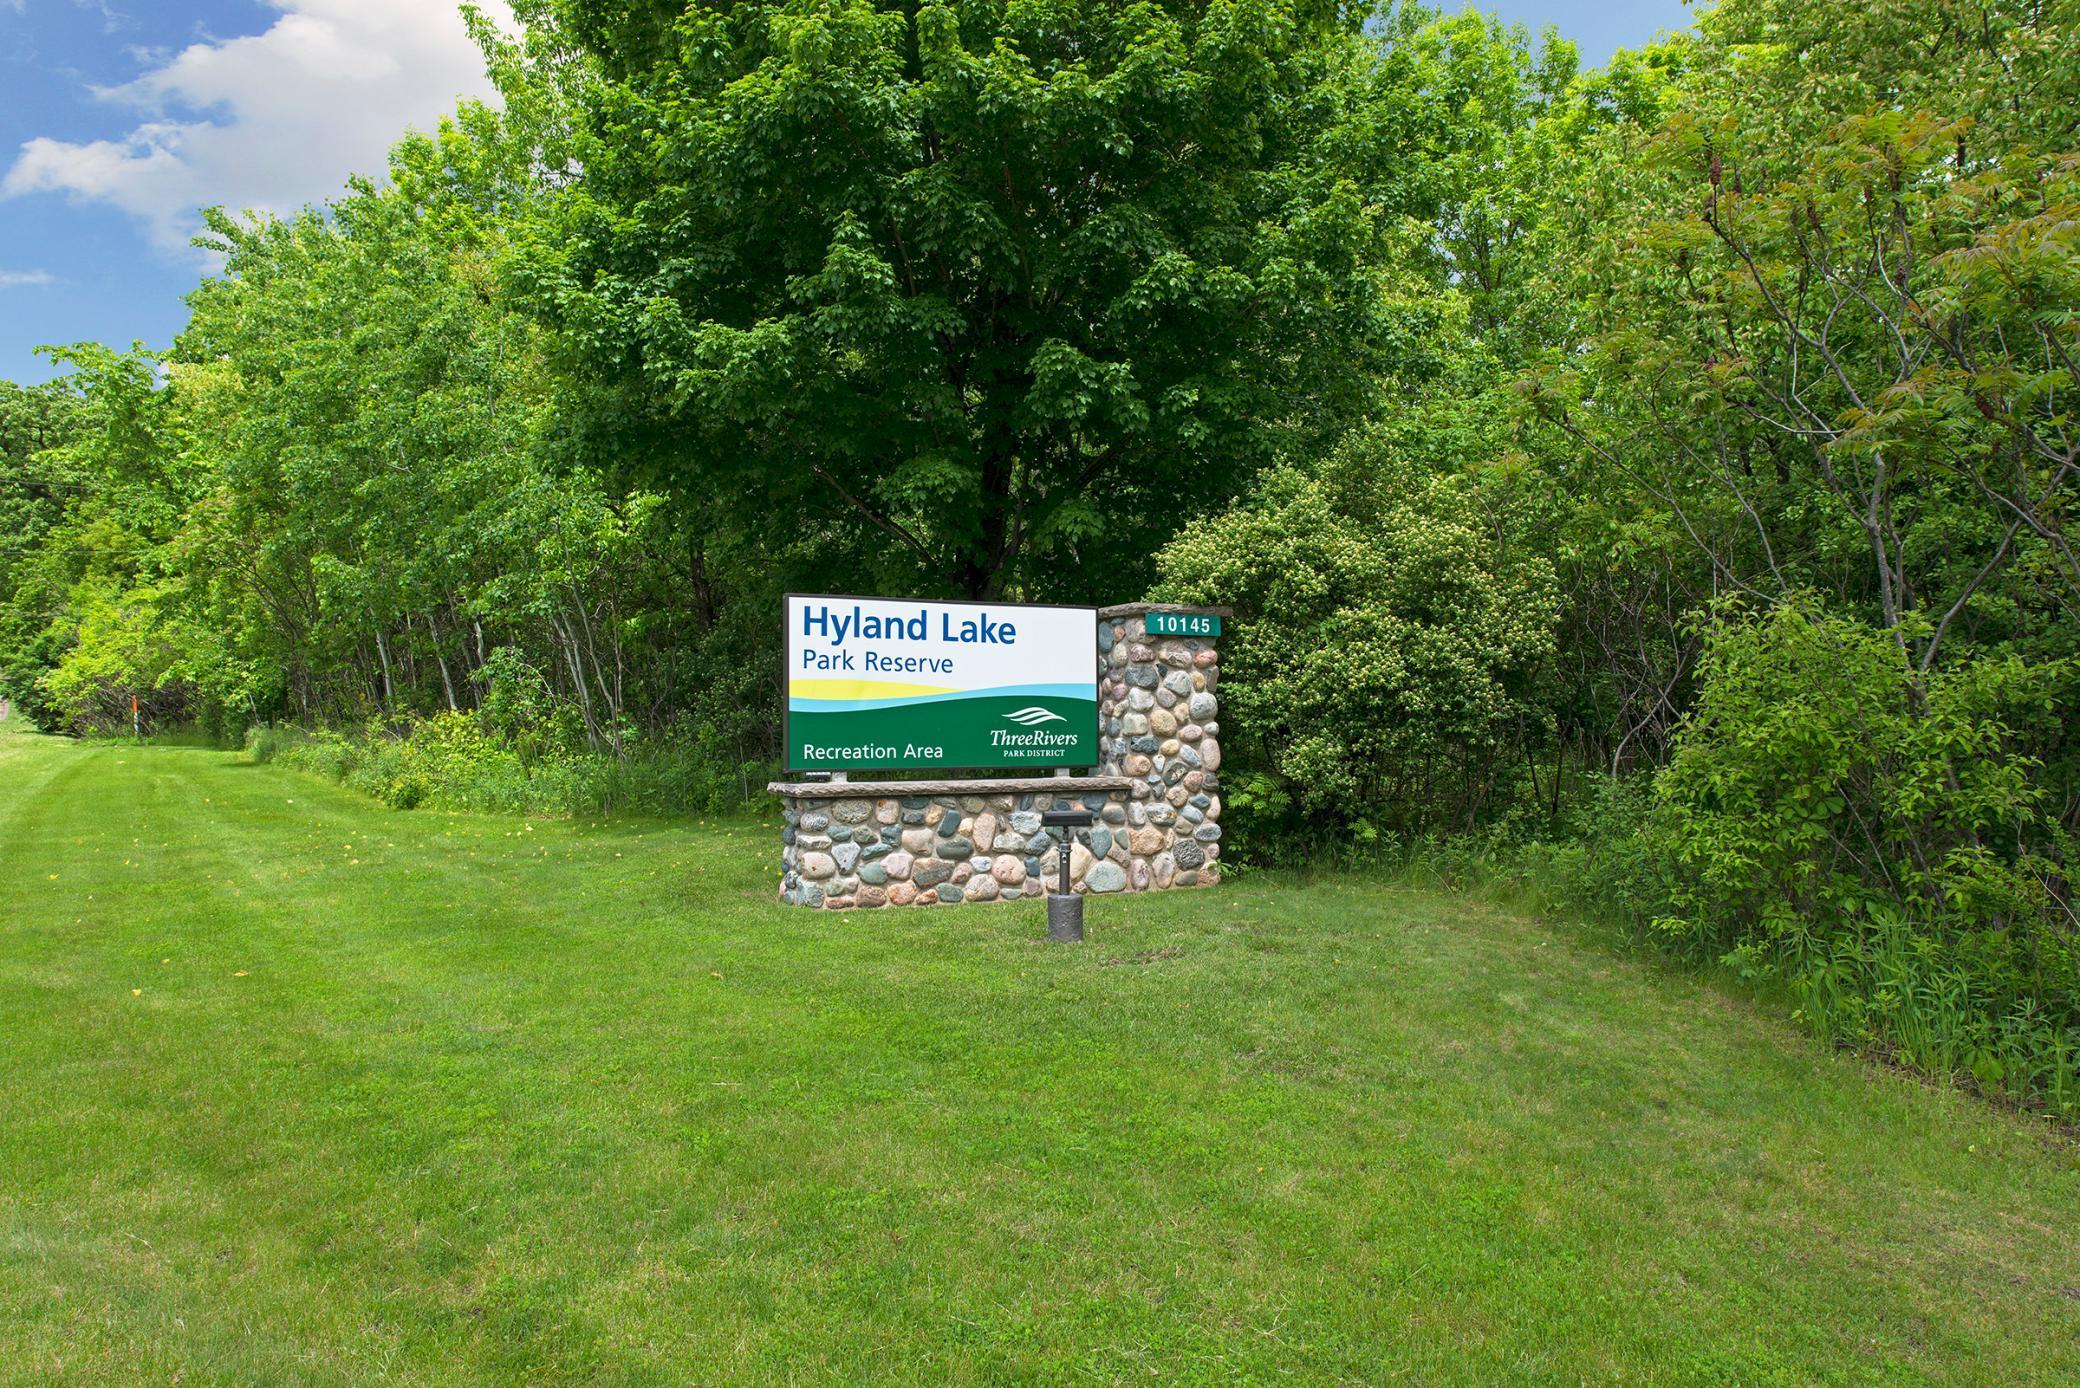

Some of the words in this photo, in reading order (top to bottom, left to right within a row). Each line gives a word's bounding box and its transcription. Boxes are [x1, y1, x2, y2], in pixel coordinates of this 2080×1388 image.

[803, 605, 928, 646] Hyland
[942, 612, 1017, 645] Lake
[1157, 616, 1210, 633] 10145
[803, 649, 855, 671] Park
[865, 651, 954, 674] Reserve
[803, 743, 897, 760] Recreation
[903, 743, 943, 759] Area
[1003, 749, 1025, 757] PARK
[1026, 749, 1065, 757] DISTRICT
